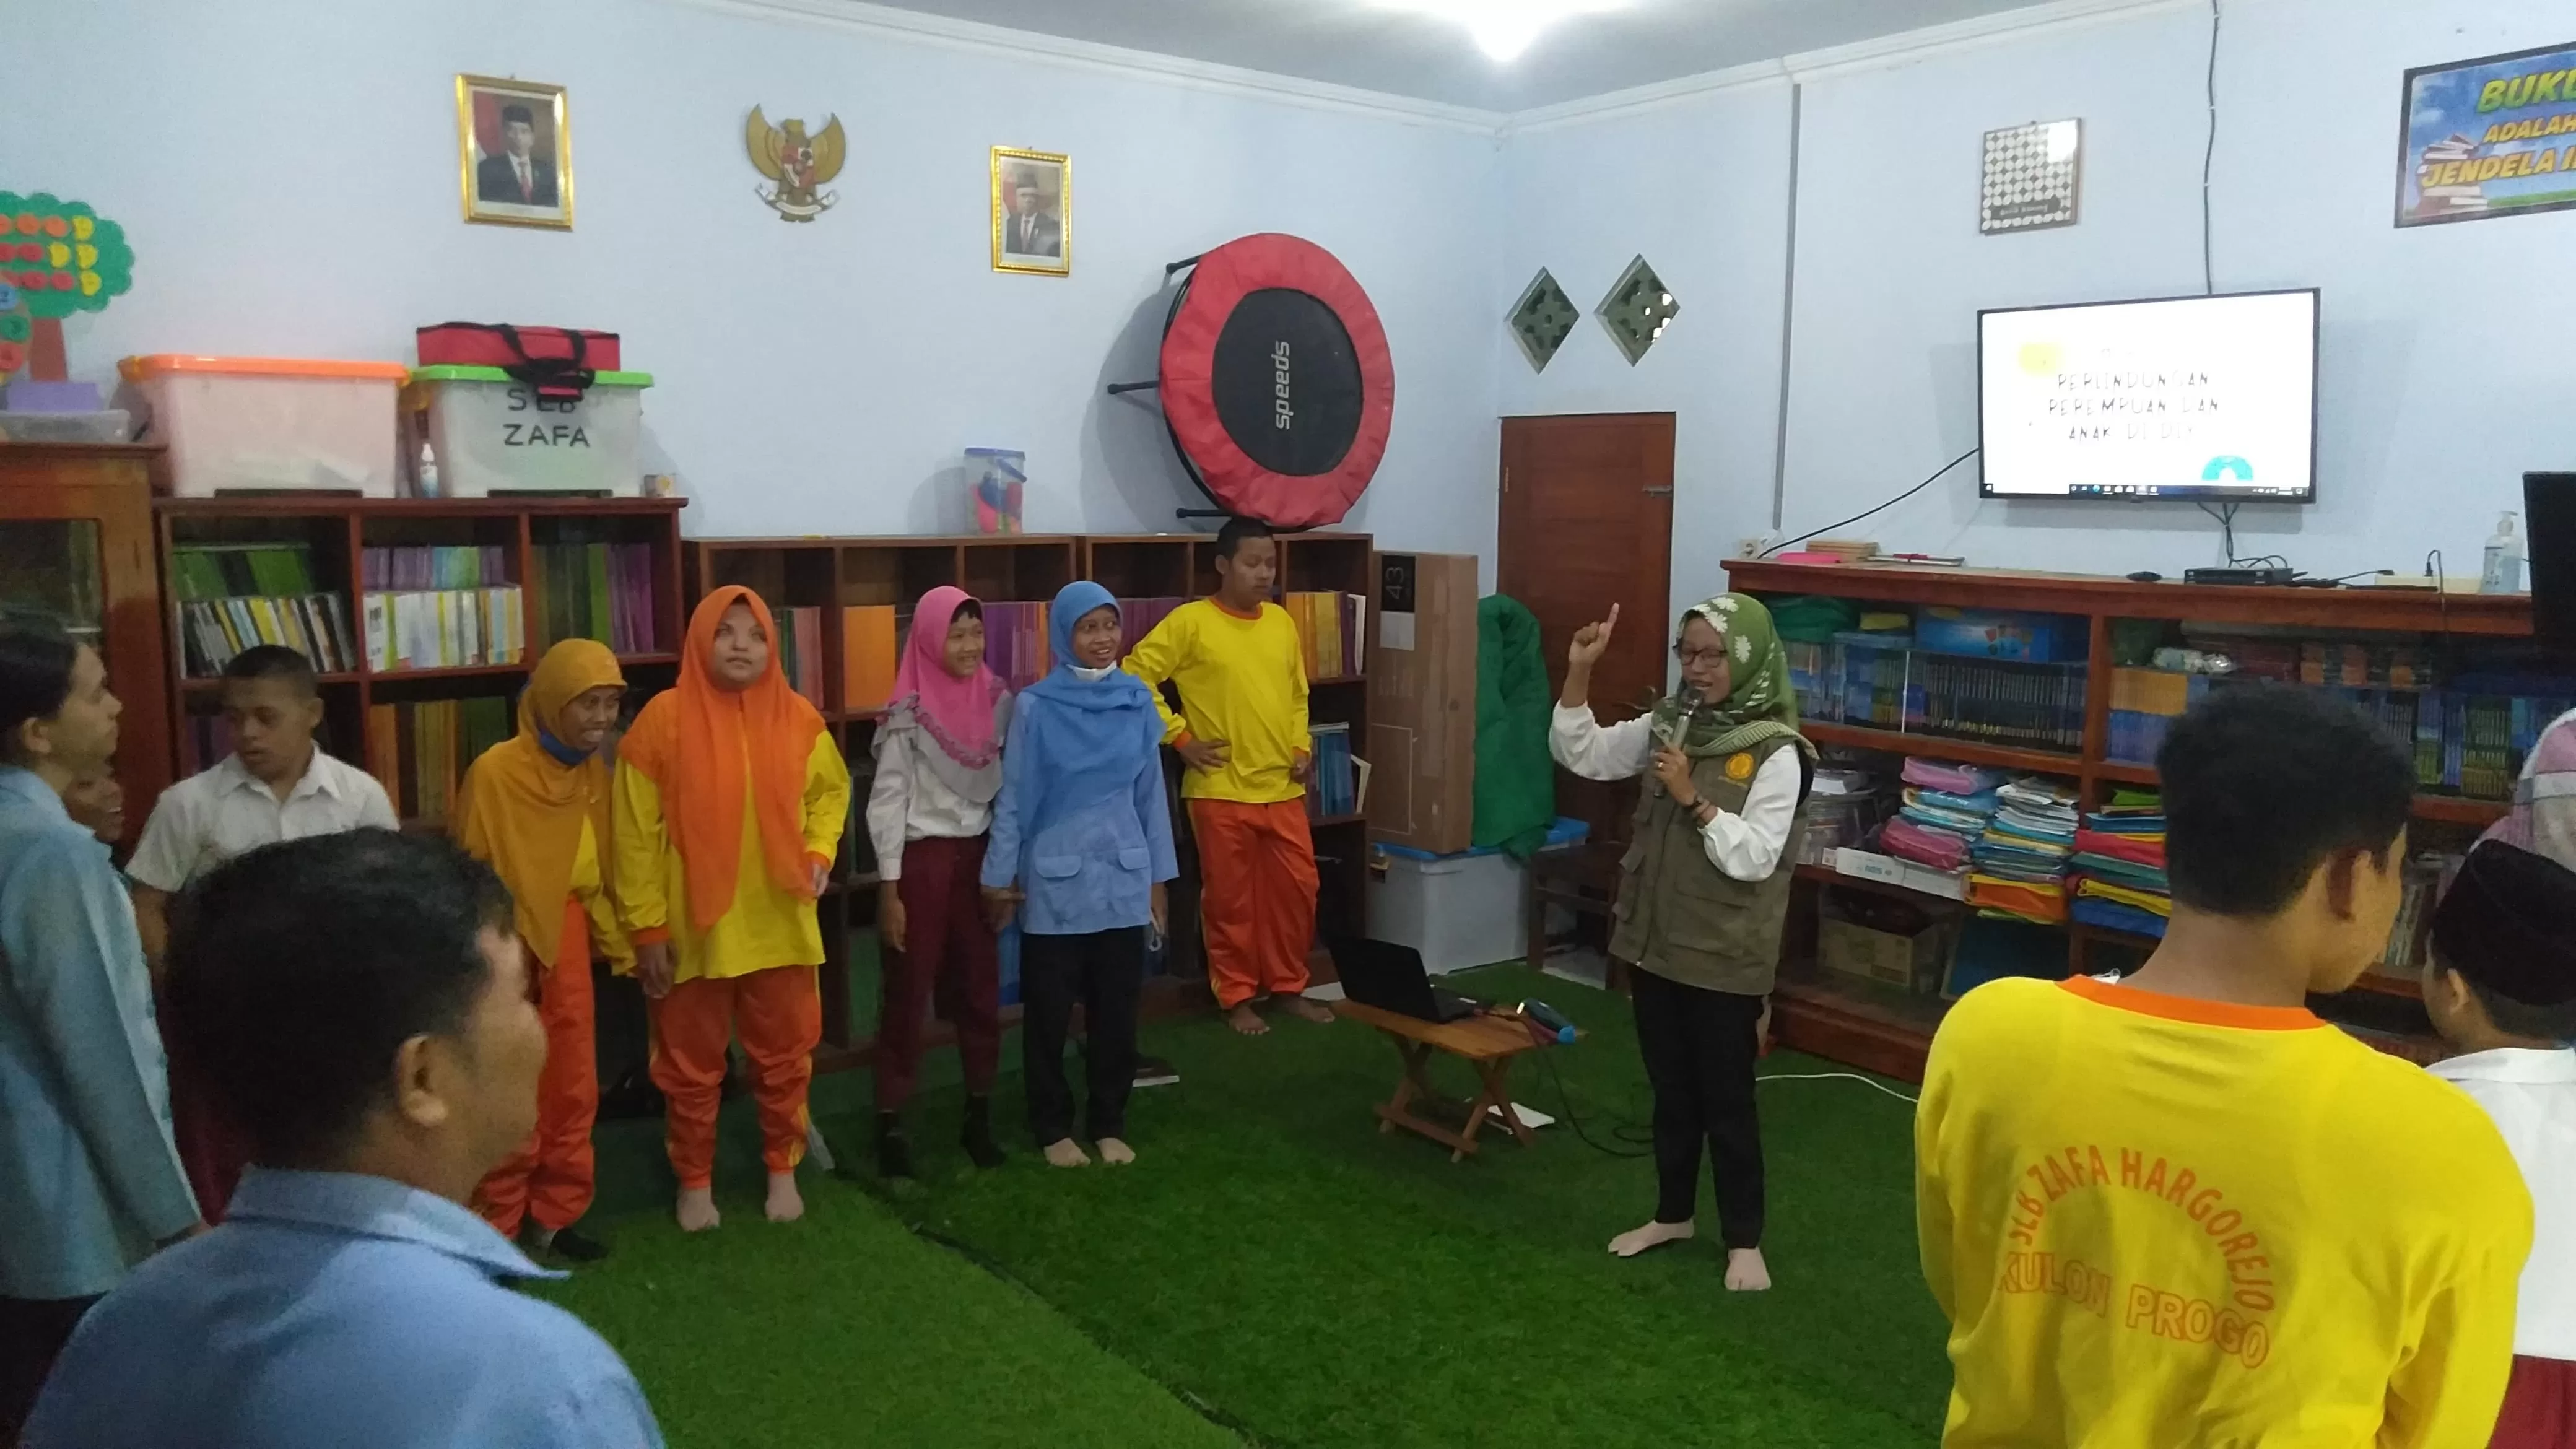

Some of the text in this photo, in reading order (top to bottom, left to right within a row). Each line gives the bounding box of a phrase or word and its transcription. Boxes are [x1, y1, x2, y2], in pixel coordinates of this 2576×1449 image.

[2484, 114, 2576, 143] ADALAH
[2421, 147, 2555, 187] JENDELA
[1271, 340, 1294, 429] speeds
[2058, 372, 2209, 391] PERLINDUNGAN
[2049, 398, 2167, 416] PEREMPUAN
[502, 423, 590, 447] ZAFA
[2069, 424, 2110, 440] ANAK
[2026, 1145, 2111, 1202] ZAFA
[2121, 1147, 2274, 1312] HARGOREJO
[1998, 1251, 2269, 1368] KULON PROGO
